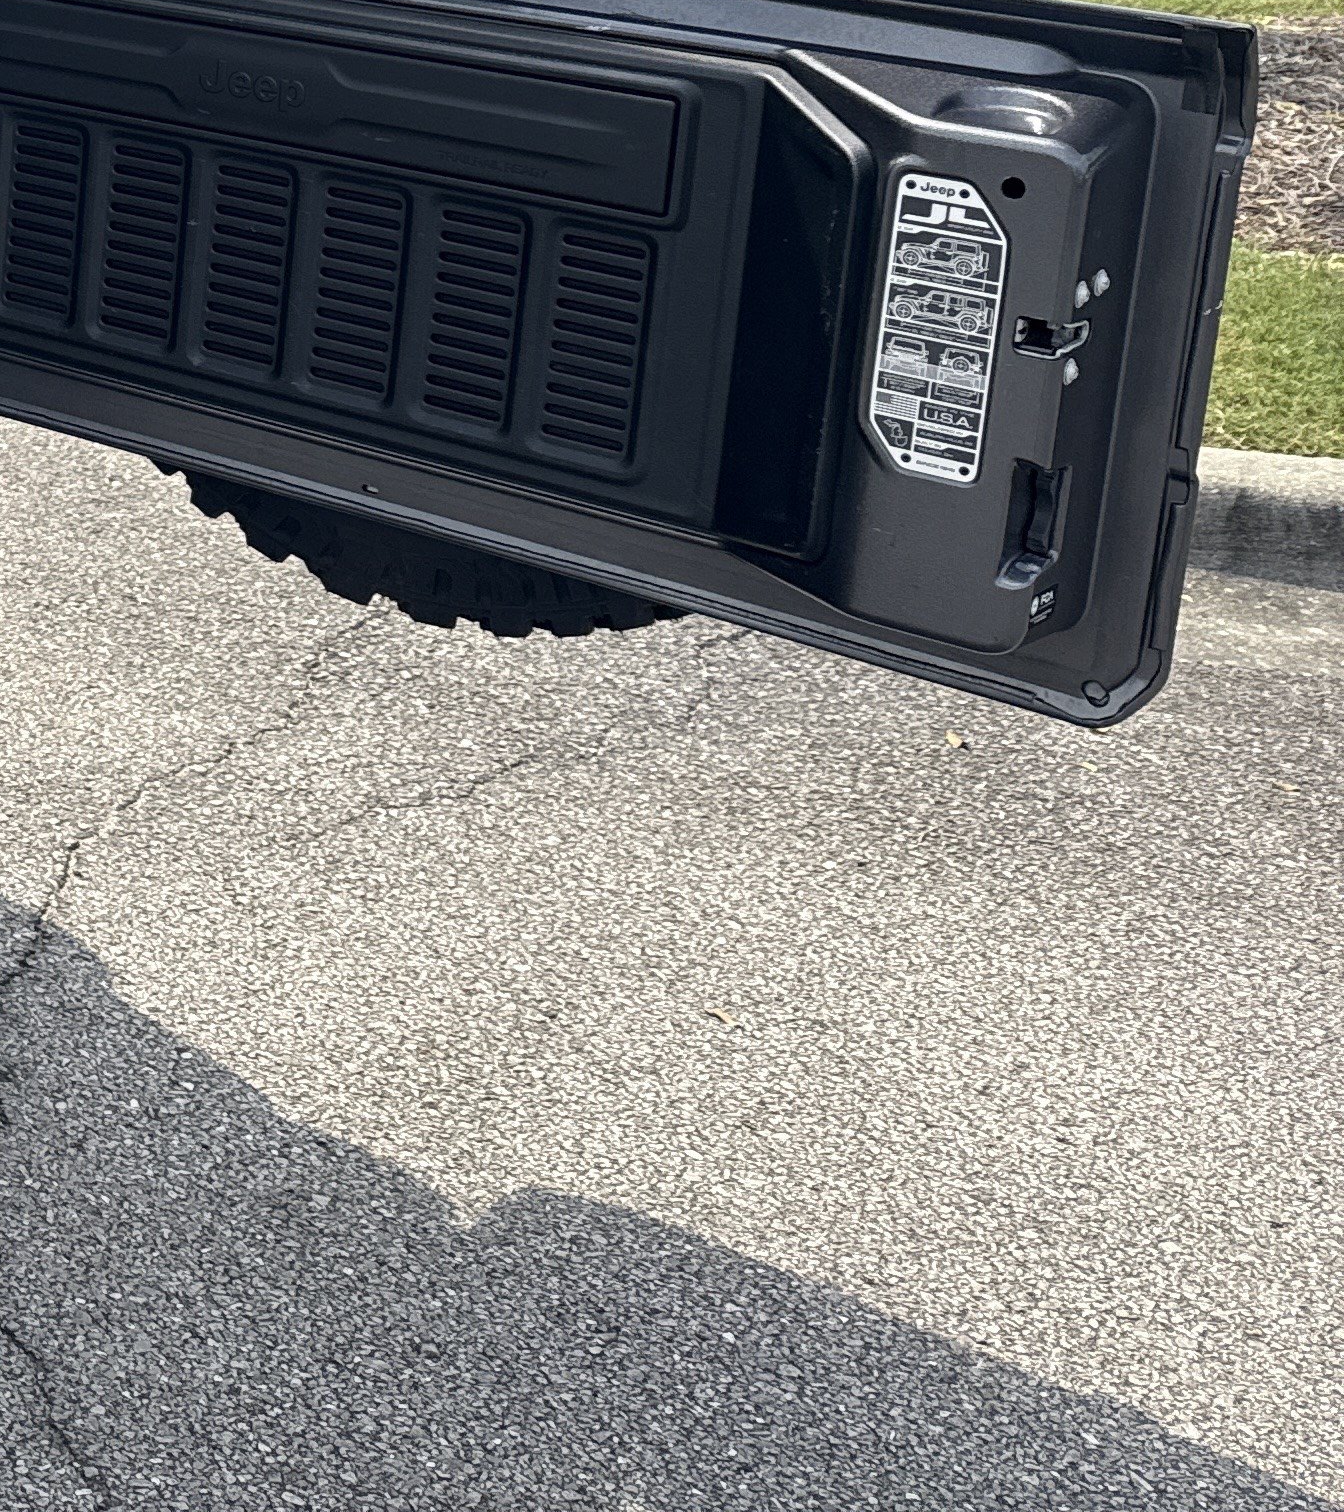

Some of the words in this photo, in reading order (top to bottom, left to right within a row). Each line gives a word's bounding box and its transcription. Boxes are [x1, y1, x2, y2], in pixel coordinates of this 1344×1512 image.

[199, 58, 306, 114] Jeep
[919, 181, 956, 198] Jeep
[901, 202, 991, 229] JL
